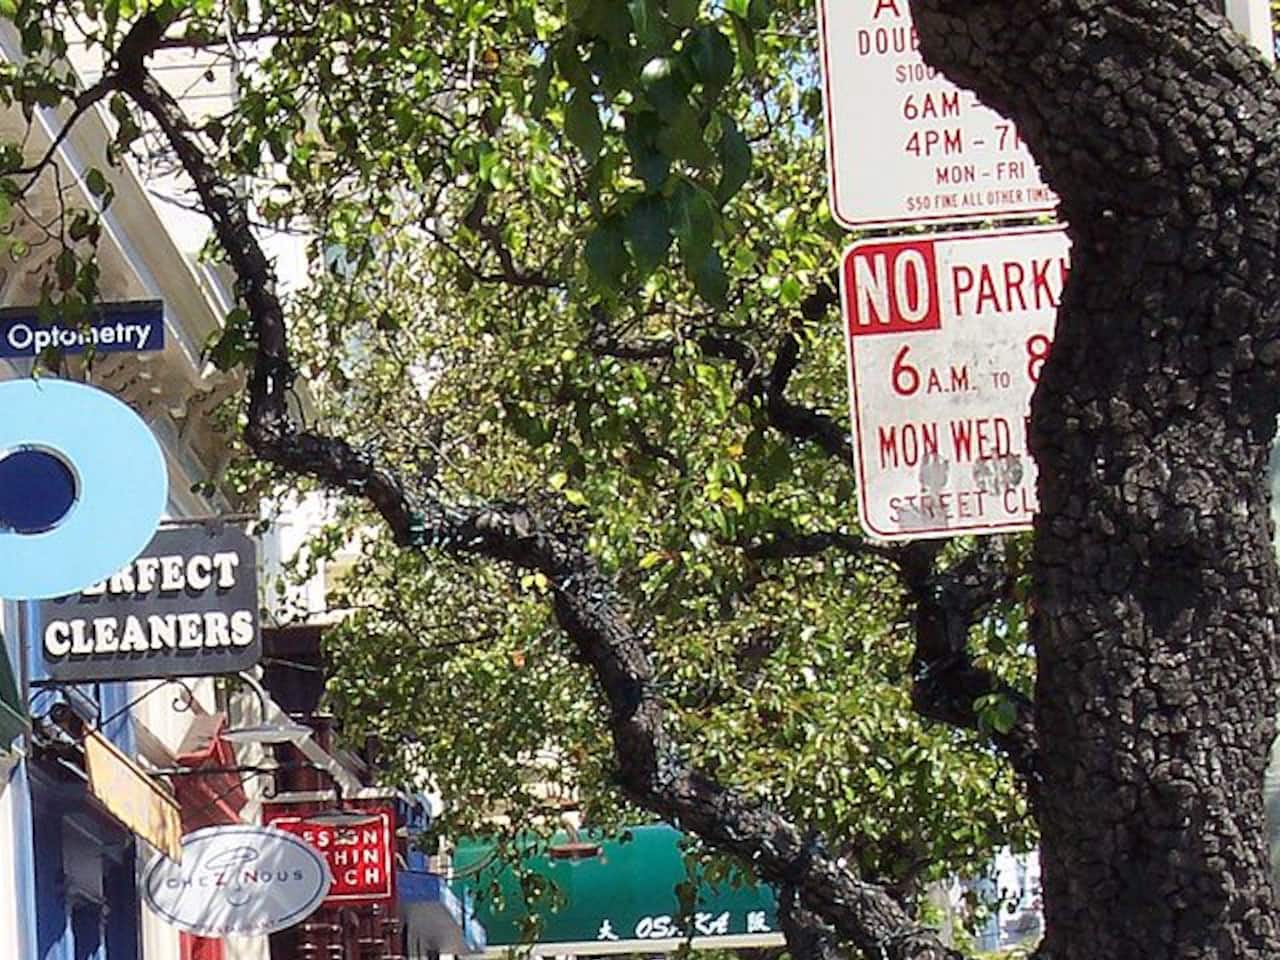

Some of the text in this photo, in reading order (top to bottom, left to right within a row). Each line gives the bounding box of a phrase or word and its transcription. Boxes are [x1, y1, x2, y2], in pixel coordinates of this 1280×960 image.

[903, 91, 961, 120] 6AM
[905, 128, 963, 157] 4PM
[936, 165, 976, 185] MON
[996, 161, 1025, 181] FRI
[934, 193, 958, 209] FINE
[961, 191, 984, 207] ALL
[986, 189, 1023, 206] OTHER
[853, 249, 930, 326] NO
[992, 372, 1011, 389] TO
[878, 423, 938, 469] MON
[950, 417, 1011, 463] WED
[889, 487, 1038, 523] STREET CL
[81, 552, 239, 596] RFECT
[45, 610, 254, 657] CLEANERS
[167, 869, 303, 889] CHEZ NOUS
[635, 911, 730, 940] OSKA
